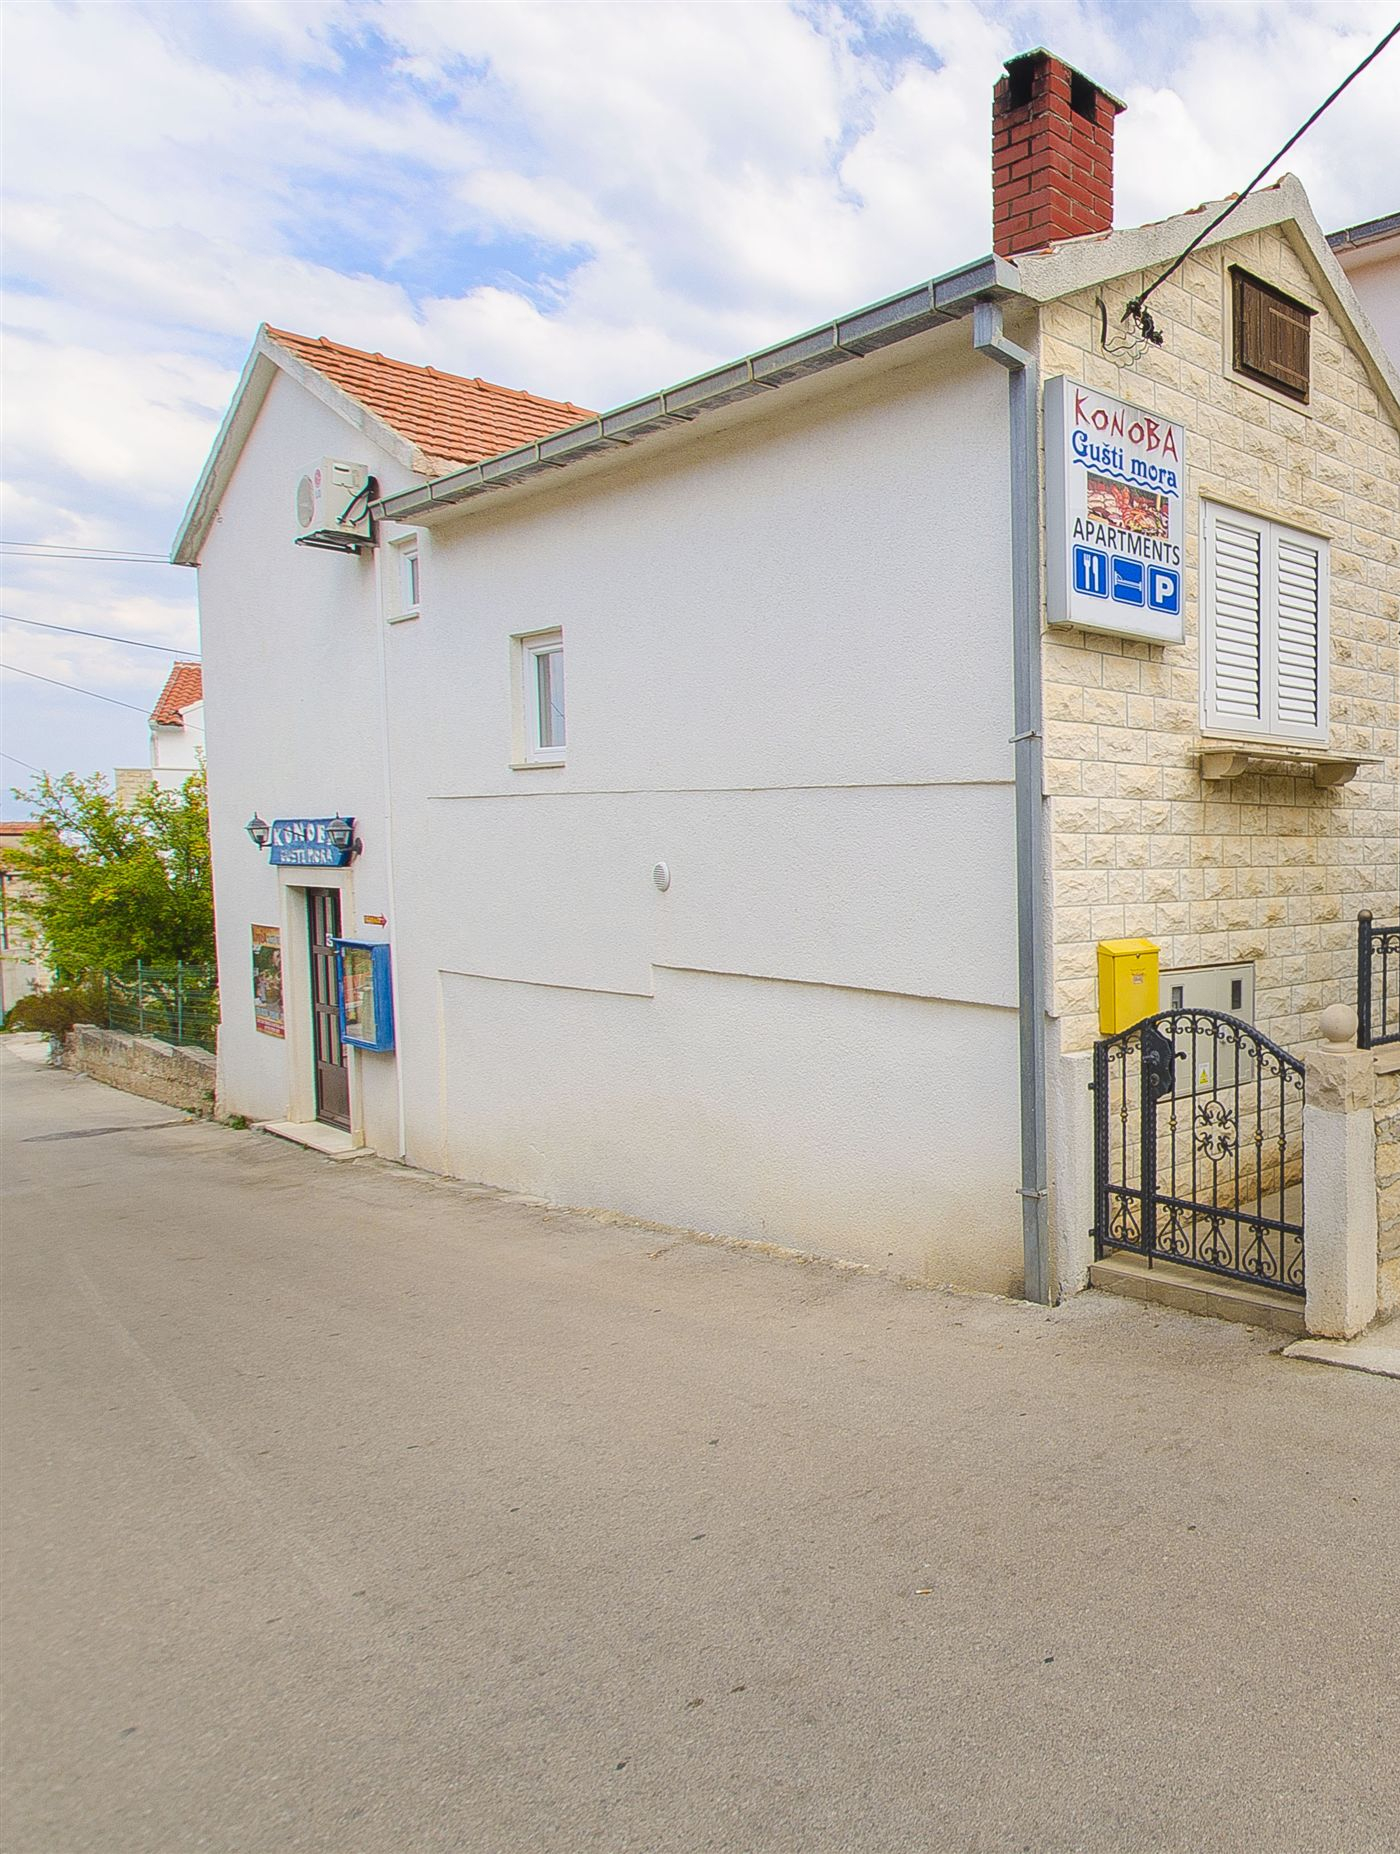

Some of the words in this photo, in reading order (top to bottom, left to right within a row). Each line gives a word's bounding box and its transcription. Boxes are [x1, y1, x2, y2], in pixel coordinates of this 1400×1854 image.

[1075, 388, 1179, 463] KONOBA
[1072, 430, 1124, 471] Gušti
[1130, 458, 1178, 489] mora
[1073, 517, 1180, 566] APARTMENTS
[1155, 574, 1175, 604] P
[273, 822, 332, 846] KONOB
